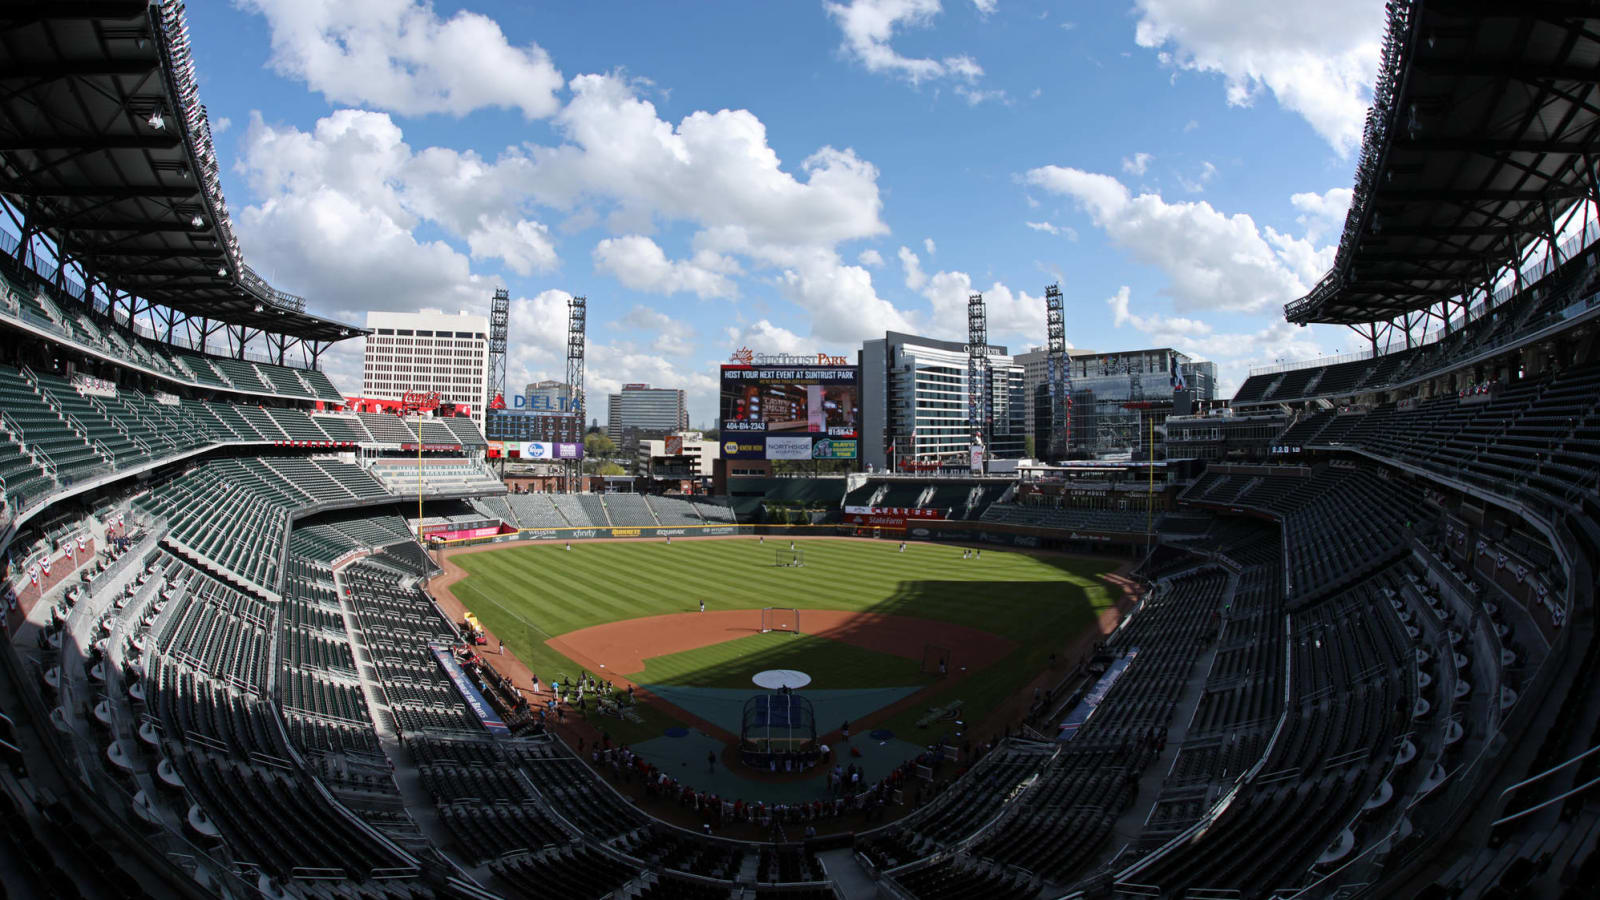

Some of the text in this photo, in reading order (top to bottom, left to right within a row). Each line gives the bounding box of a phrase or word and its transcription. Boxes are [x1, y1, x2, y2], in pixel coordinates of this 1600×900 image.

[725, 371, 854, 379] HOST YOUR NEXT EVENT AT SUNTRUST PARK
[514, 395, 580, 411] DELTA
[573, 529, 597, 538] xfinity
